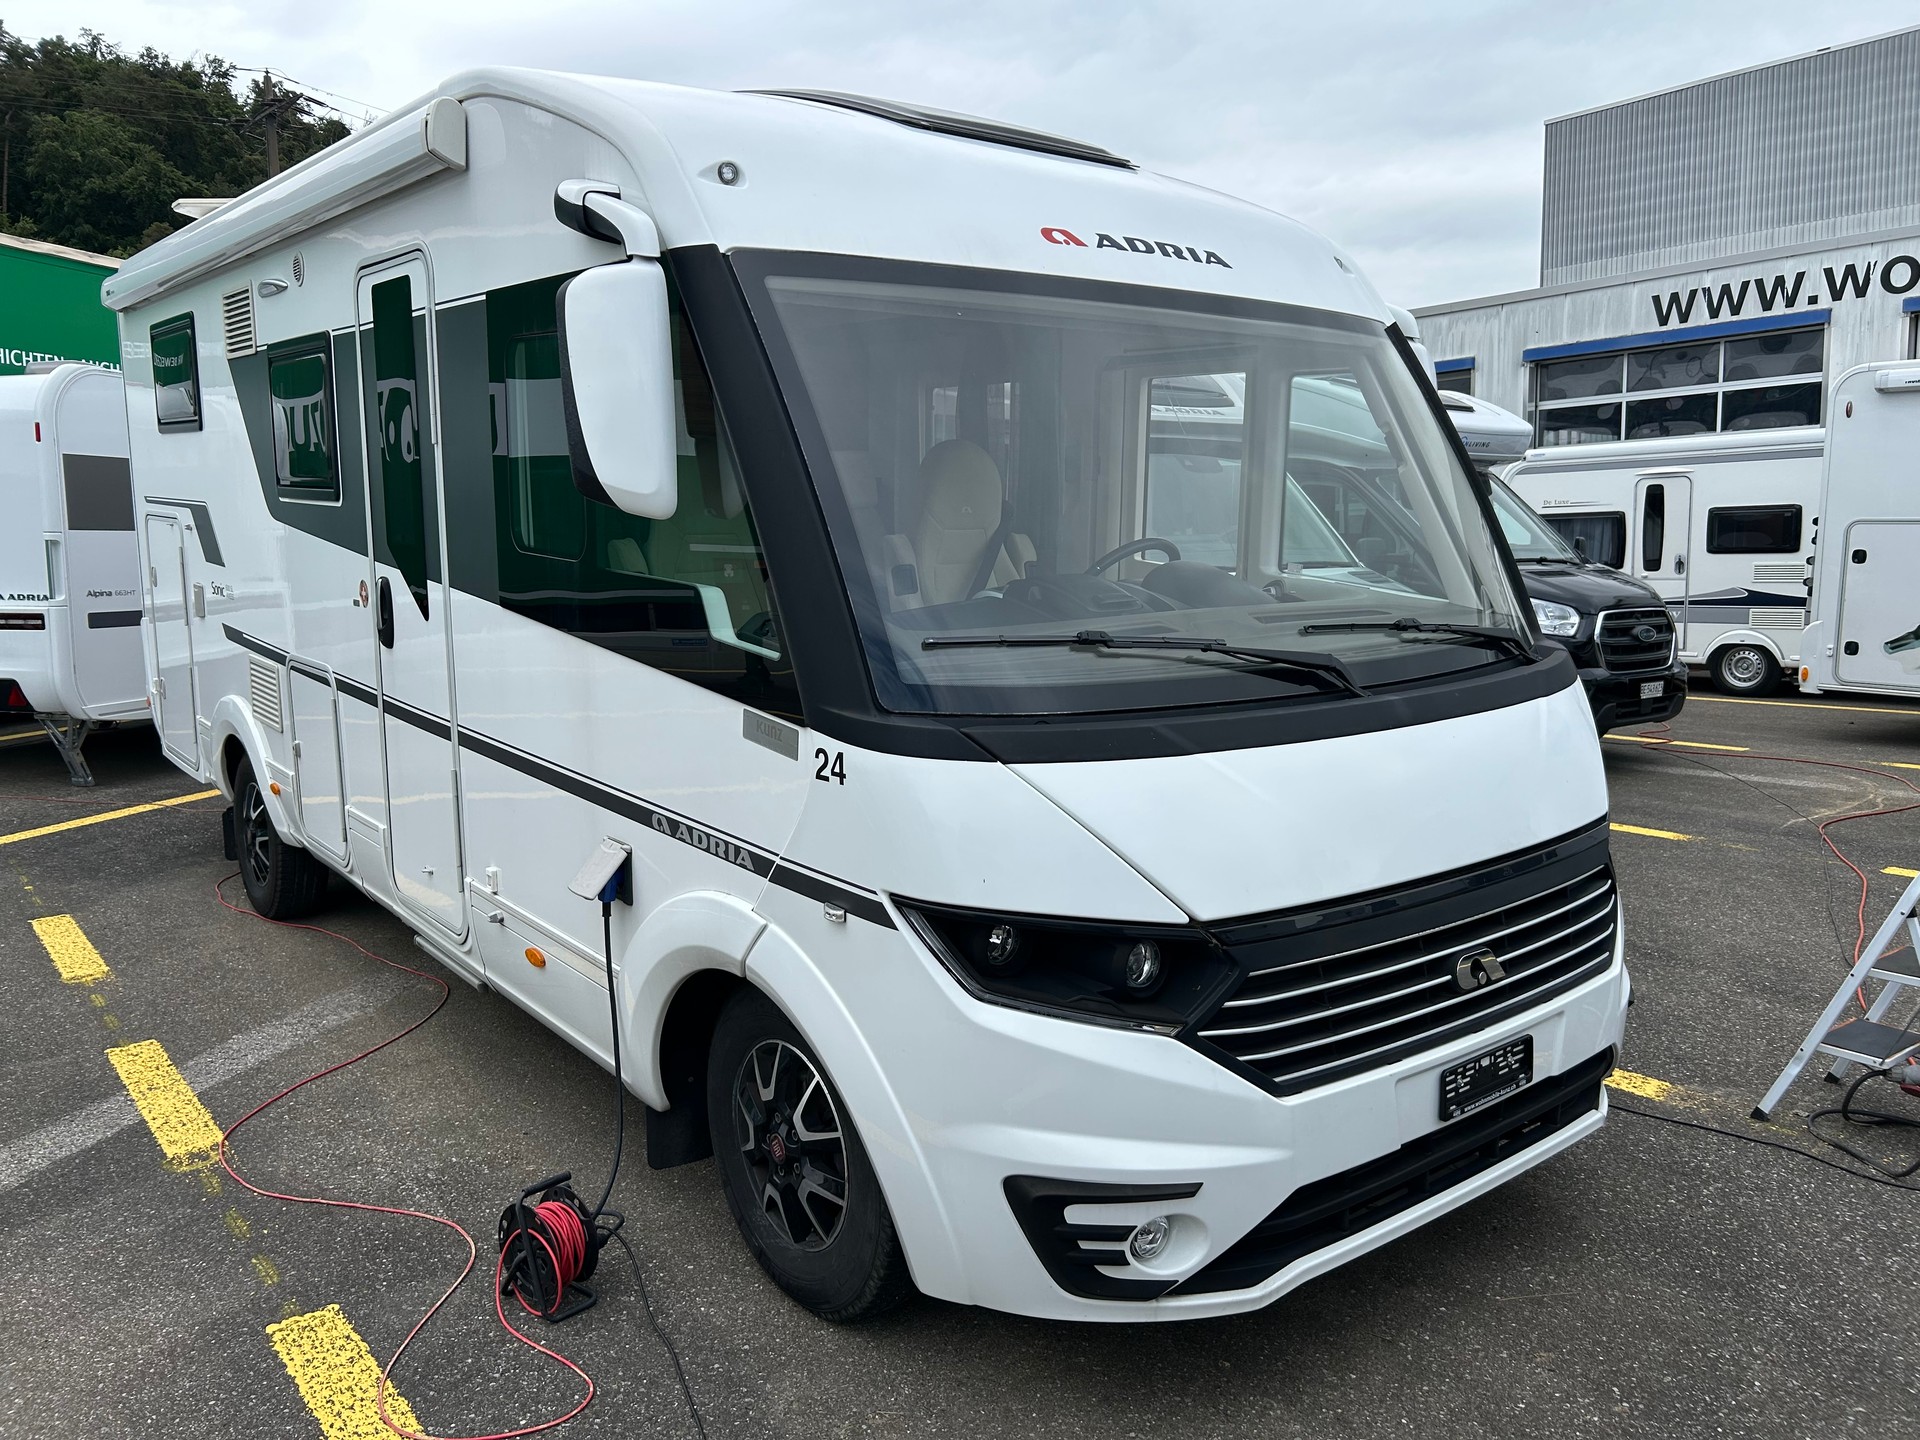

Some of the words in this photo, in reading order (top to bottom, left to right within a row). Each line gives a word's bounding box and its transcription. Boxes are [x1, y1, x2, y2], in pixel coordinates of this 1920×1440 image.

[1095, 232, 1234, 270] ADRIA
[7, 593, 50, 602] ADRIA
[86, 590, 113, 598] Alpina
[814, 747, 847, 786] 24
[675, 822, 755, 871] ADRIA
